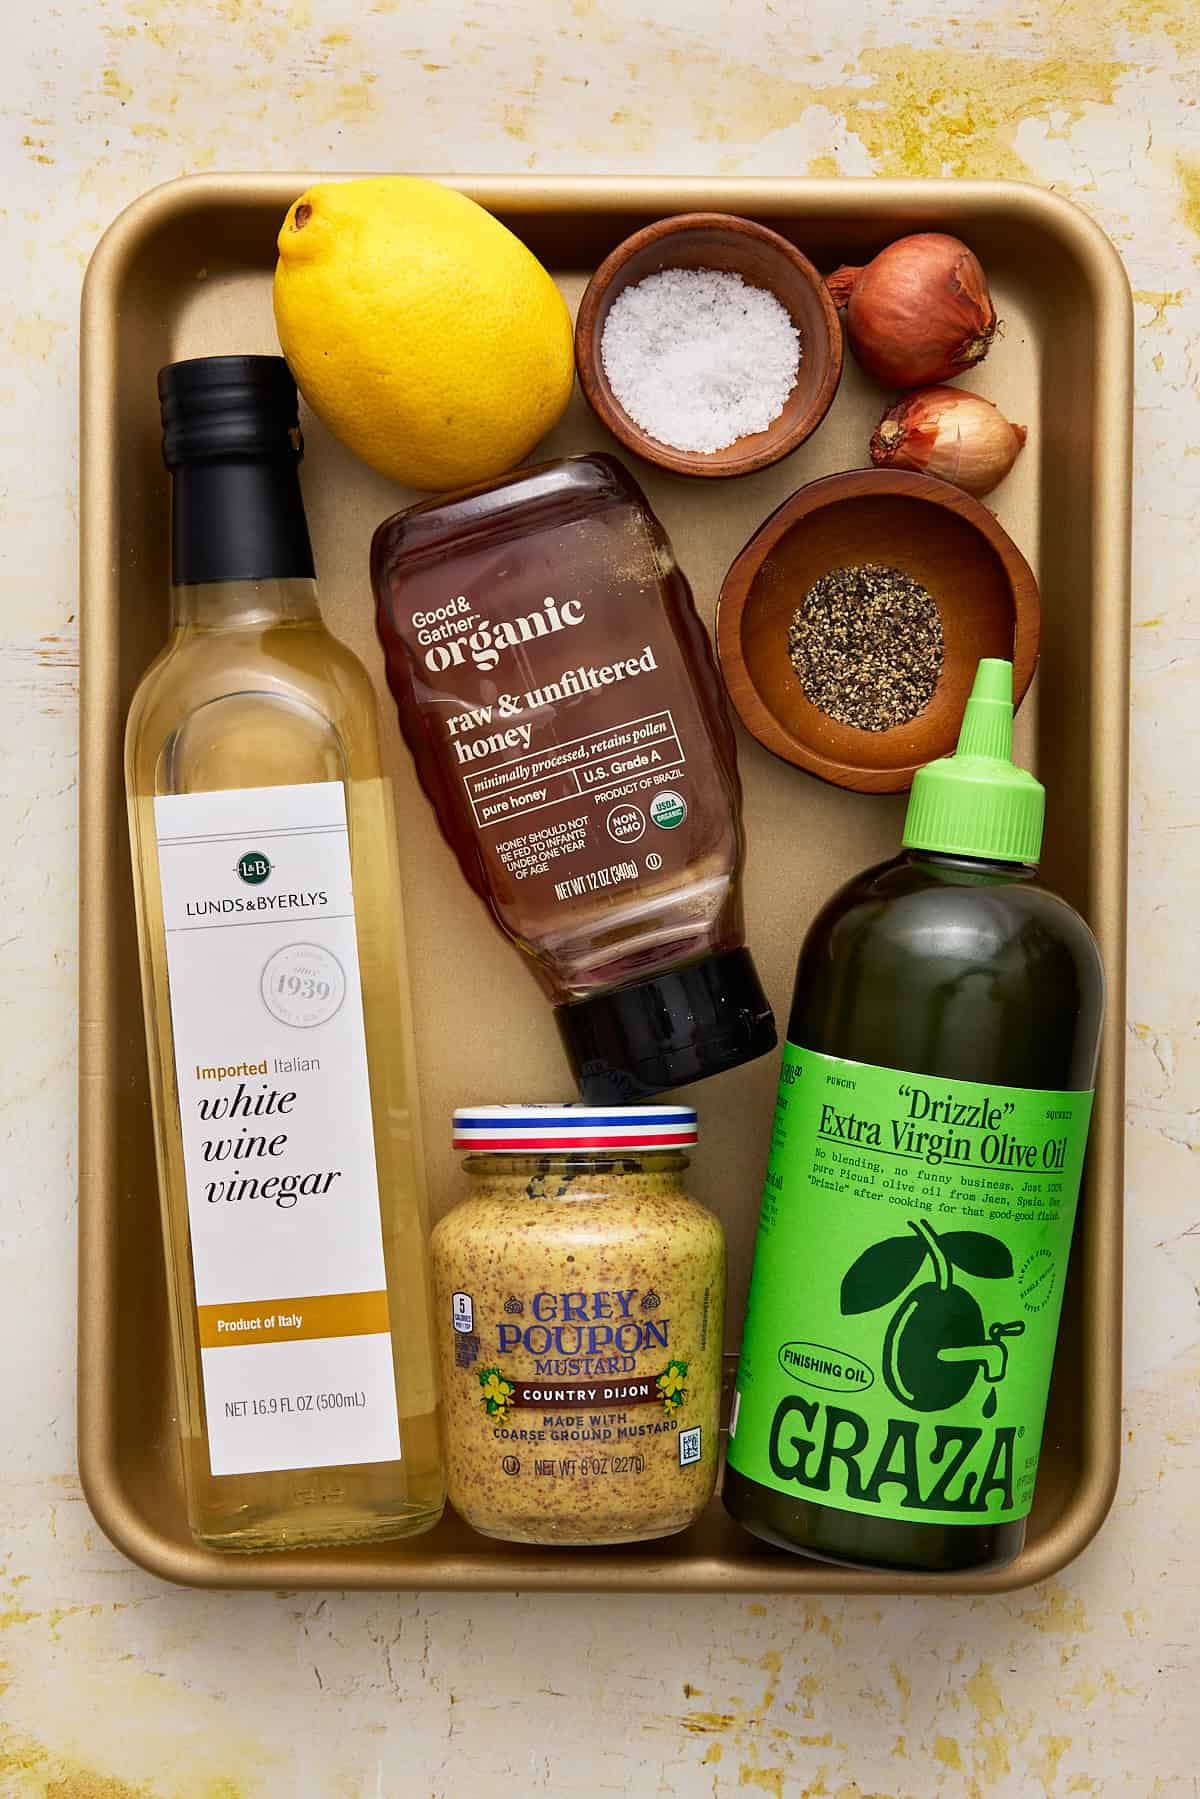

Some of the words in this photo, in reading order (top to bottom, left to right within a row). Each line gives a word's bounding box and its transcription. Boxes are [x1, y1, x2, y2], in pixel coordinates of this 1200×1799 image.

[412, 596, 472, 628] Good&
[425, 597, 585, 671] organic
[445, 705, 493, 735] raw
[498, 694, 522, 717] &
[526, 646, 658, 709] unfiltered
[453, 723, 533, 765] honey
[473, 766, 530, 793] minimally
[530, 748, 590, 777] processed,
[591, 733, 631, 759] retains
[631, 721, 667, 745] pollen
[583, 767, 610, 783] U.S.
[611, 754, 649, 776] Grade
[650, 749, 662, 763] A
[594, 782, 638, 804] PRODUCT
[639, 777, 653, 789] OF
[653, 769, 684, 784] BRAZIL
[482, 801, 510, 820] pure
[511, 787, 547, 808] honey
[613, 812, 637, 827] NON
[656, 799, 677, 811] USDA
[495, 836, 527, 853] HONEY
[528, 823, 567, 843] SHOULD
[568, 816, 589, 830] NOT
[615, 821, 640, 836] GMO
[500, 852, 513, 863] BE
[513, 847, 531, 860] FED
[531, 840, 545, 851] TO
[546, 828, 586, 848] INFANTS
[506, 855, 538, 872] UNDER
[538, 848, 560, 861] ONE
[561, 840, 585, 854] YEAR
[241, 860, 267, 877] L&B
[515, 868, 528, 880] OF
[530, 862, 550, 875] AGE
[554, 880, 572, 901] NET
[572, 876, 586, 895] WT
[587, 872, 599, 891] 12
[598, 868, 612, 887] OZ
[610, 860, 639, 884] (340g)
[278, 974, 330, 1000] 1939
[195, 1060, 268, 1082] Imported
[273, 1056, 321, 1074] Italian
[826, 1075, 857, 1090] PUNCHY
[197, 1083, 297, 1121] white
[201, 1127, 288, 1162] wine
[817, 1104, 882, 1146] Extra
[891, 1119, 970, 1165] Virgin
[981, 1133, 1037, 1167] Olive
[1042, 1137, 1067, 1168] Oil
[813, 1163, 834, 1176] pure
[840, 1169, 875, 1185] Picual
[882, 1178, 915, 1193] olive
[922, 1187, 941, 1197] oil
[950, 1188, 976, 1202] from
[815, 1148, 826, 1159] No
[832, 1152, 885, 1174] blending,
[894, 1167, 908, 1176] no
[917, 1170, 952, 1185] funny
[204, 1169, 342, 1209] vinegar
[853, 1188, 884, 1201] after
[888, 1196, 932, 1211] cooking
[938, 1202, 957, 1214] for
[962, 1205, 984, 1217] that
[989, 1208, 1034, 1221] good-good
[459, 1298, 465, 1314] 5
[532, 1289, 638, 1322] GREY
[217, 1316, 262, 1333] Product
[263, 1315, 276, 1328] of
[278, 1314, 302, 1328] Italy
[496, 1319, 671, 1356] POUPON
[535, 1356, 637, 1376] MUSTARD
[783, 1350, 842, 1378] FINISHING
[845, 1367, 868, 1384] OIL
[224, 1401, 248, 1417] NET
[252, 1398, 277, 1416] 16.9
[280, 1397, 295, 1413] FL
[297, 1395, 314, 1412] OZ
[316, 1391, 366, 1411] (500mL)
[523, 1388, 596, 1401] COUNTRY
[603, 1384, 649, 1399] DIJON
[493, 1428, 546, 1441] COARSE
[550, 1429, 611, 1441] GROUND
[617, 1420, 678, 1439] MUSTARD
[543, 1415, 584, 1427] MADE
[589, 1413, 627, 1425] WITH
[534, 1459, 557, 1475] NET
[559, 1459, 577, 1475] WT
[580, 1459, 588, 1475] 8
[591, 1458, 608, 1474] OZ
[611, 1455, 645, 1474] (227g)
[769, 1395, 1018, 1512] GRAZA
